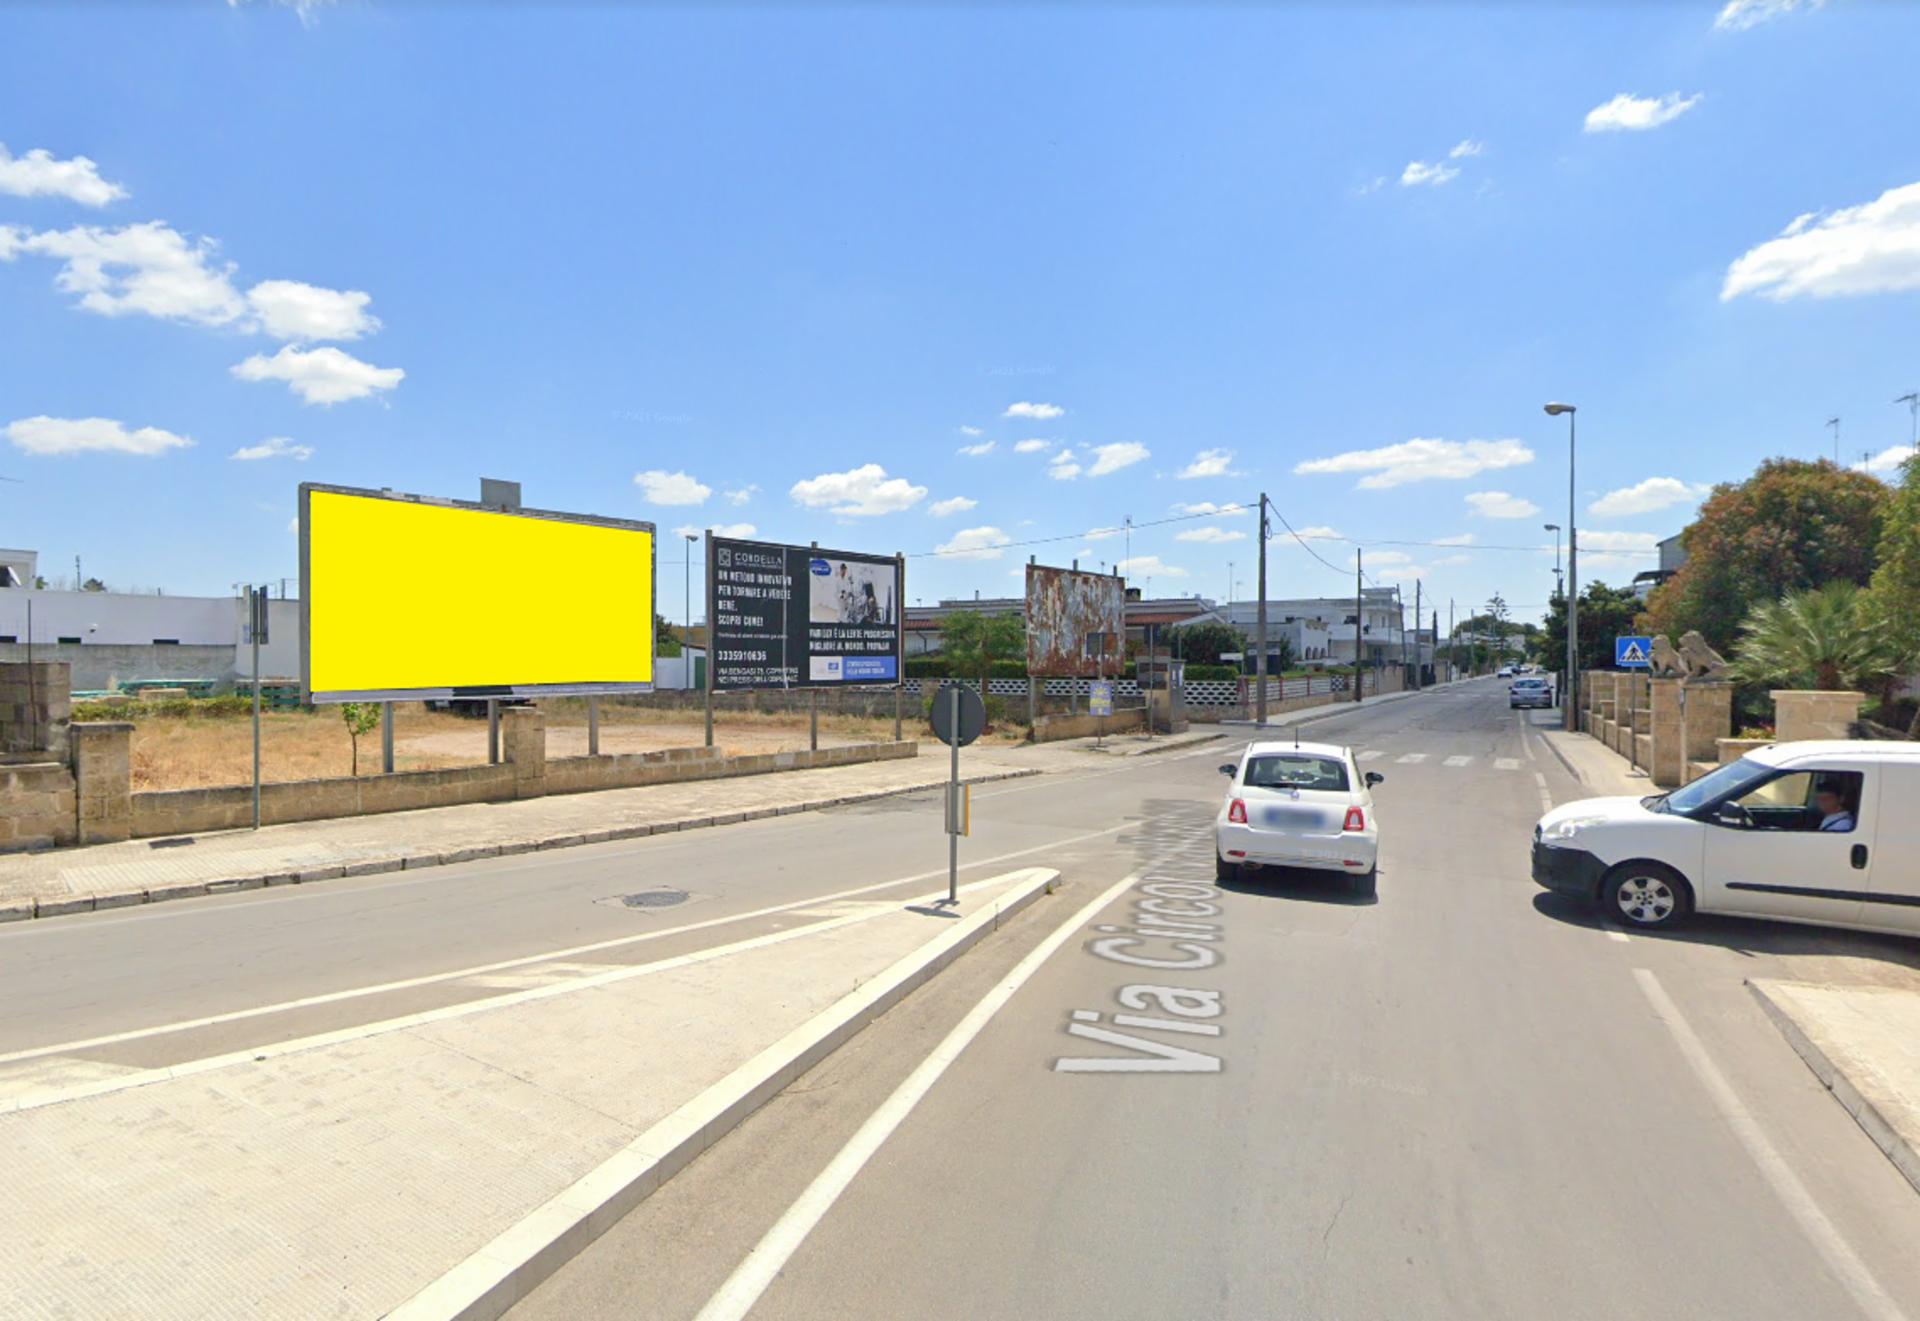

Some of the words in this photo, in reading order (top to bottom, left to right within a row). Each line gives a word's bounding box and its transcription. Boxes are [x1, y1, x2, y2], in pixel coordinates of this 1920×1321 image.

[718, 585, 731, 596] PER
[733, 586, 761, 598] TORNARE
[718, 600, 738, 612] BENE.
[718, 614, 741, 626] SCOPRI
